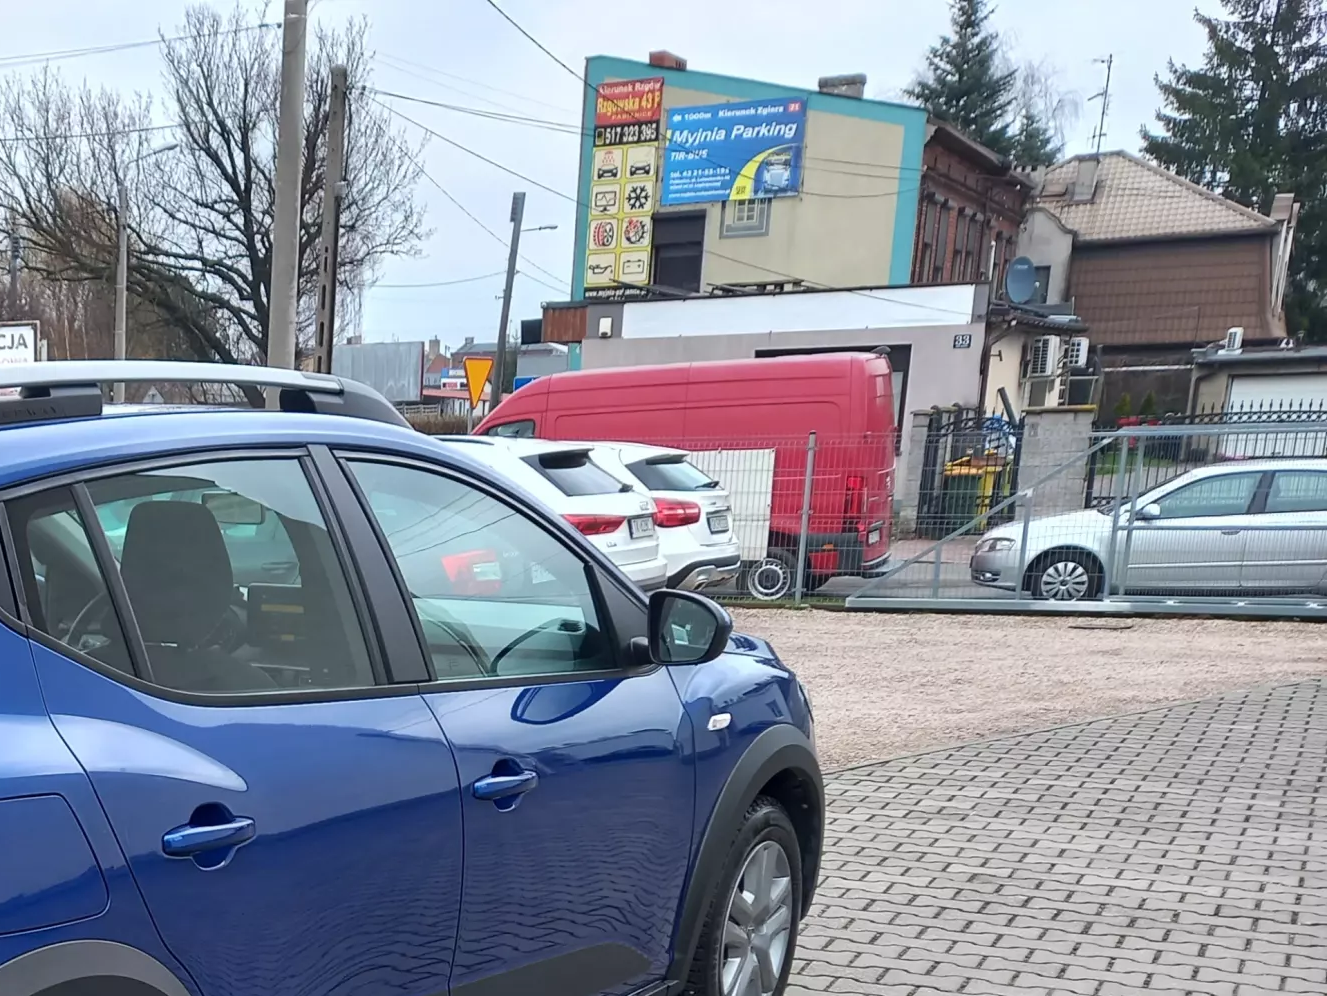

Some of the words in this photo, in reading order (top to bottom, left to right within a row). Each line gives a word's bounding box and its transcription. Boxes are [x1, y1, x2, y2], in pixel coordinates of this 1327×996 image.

[596, 93, 640, 116] Rzgowska
[605, 127, 621, 144] 517
[622, 125, 639, 142] 323
[640, 123, 657, 140] 395
[673, 126, 726, 147] Myjnia
[731, 122, 797, 140] Parking
[955, 335, 970, 345] 33
